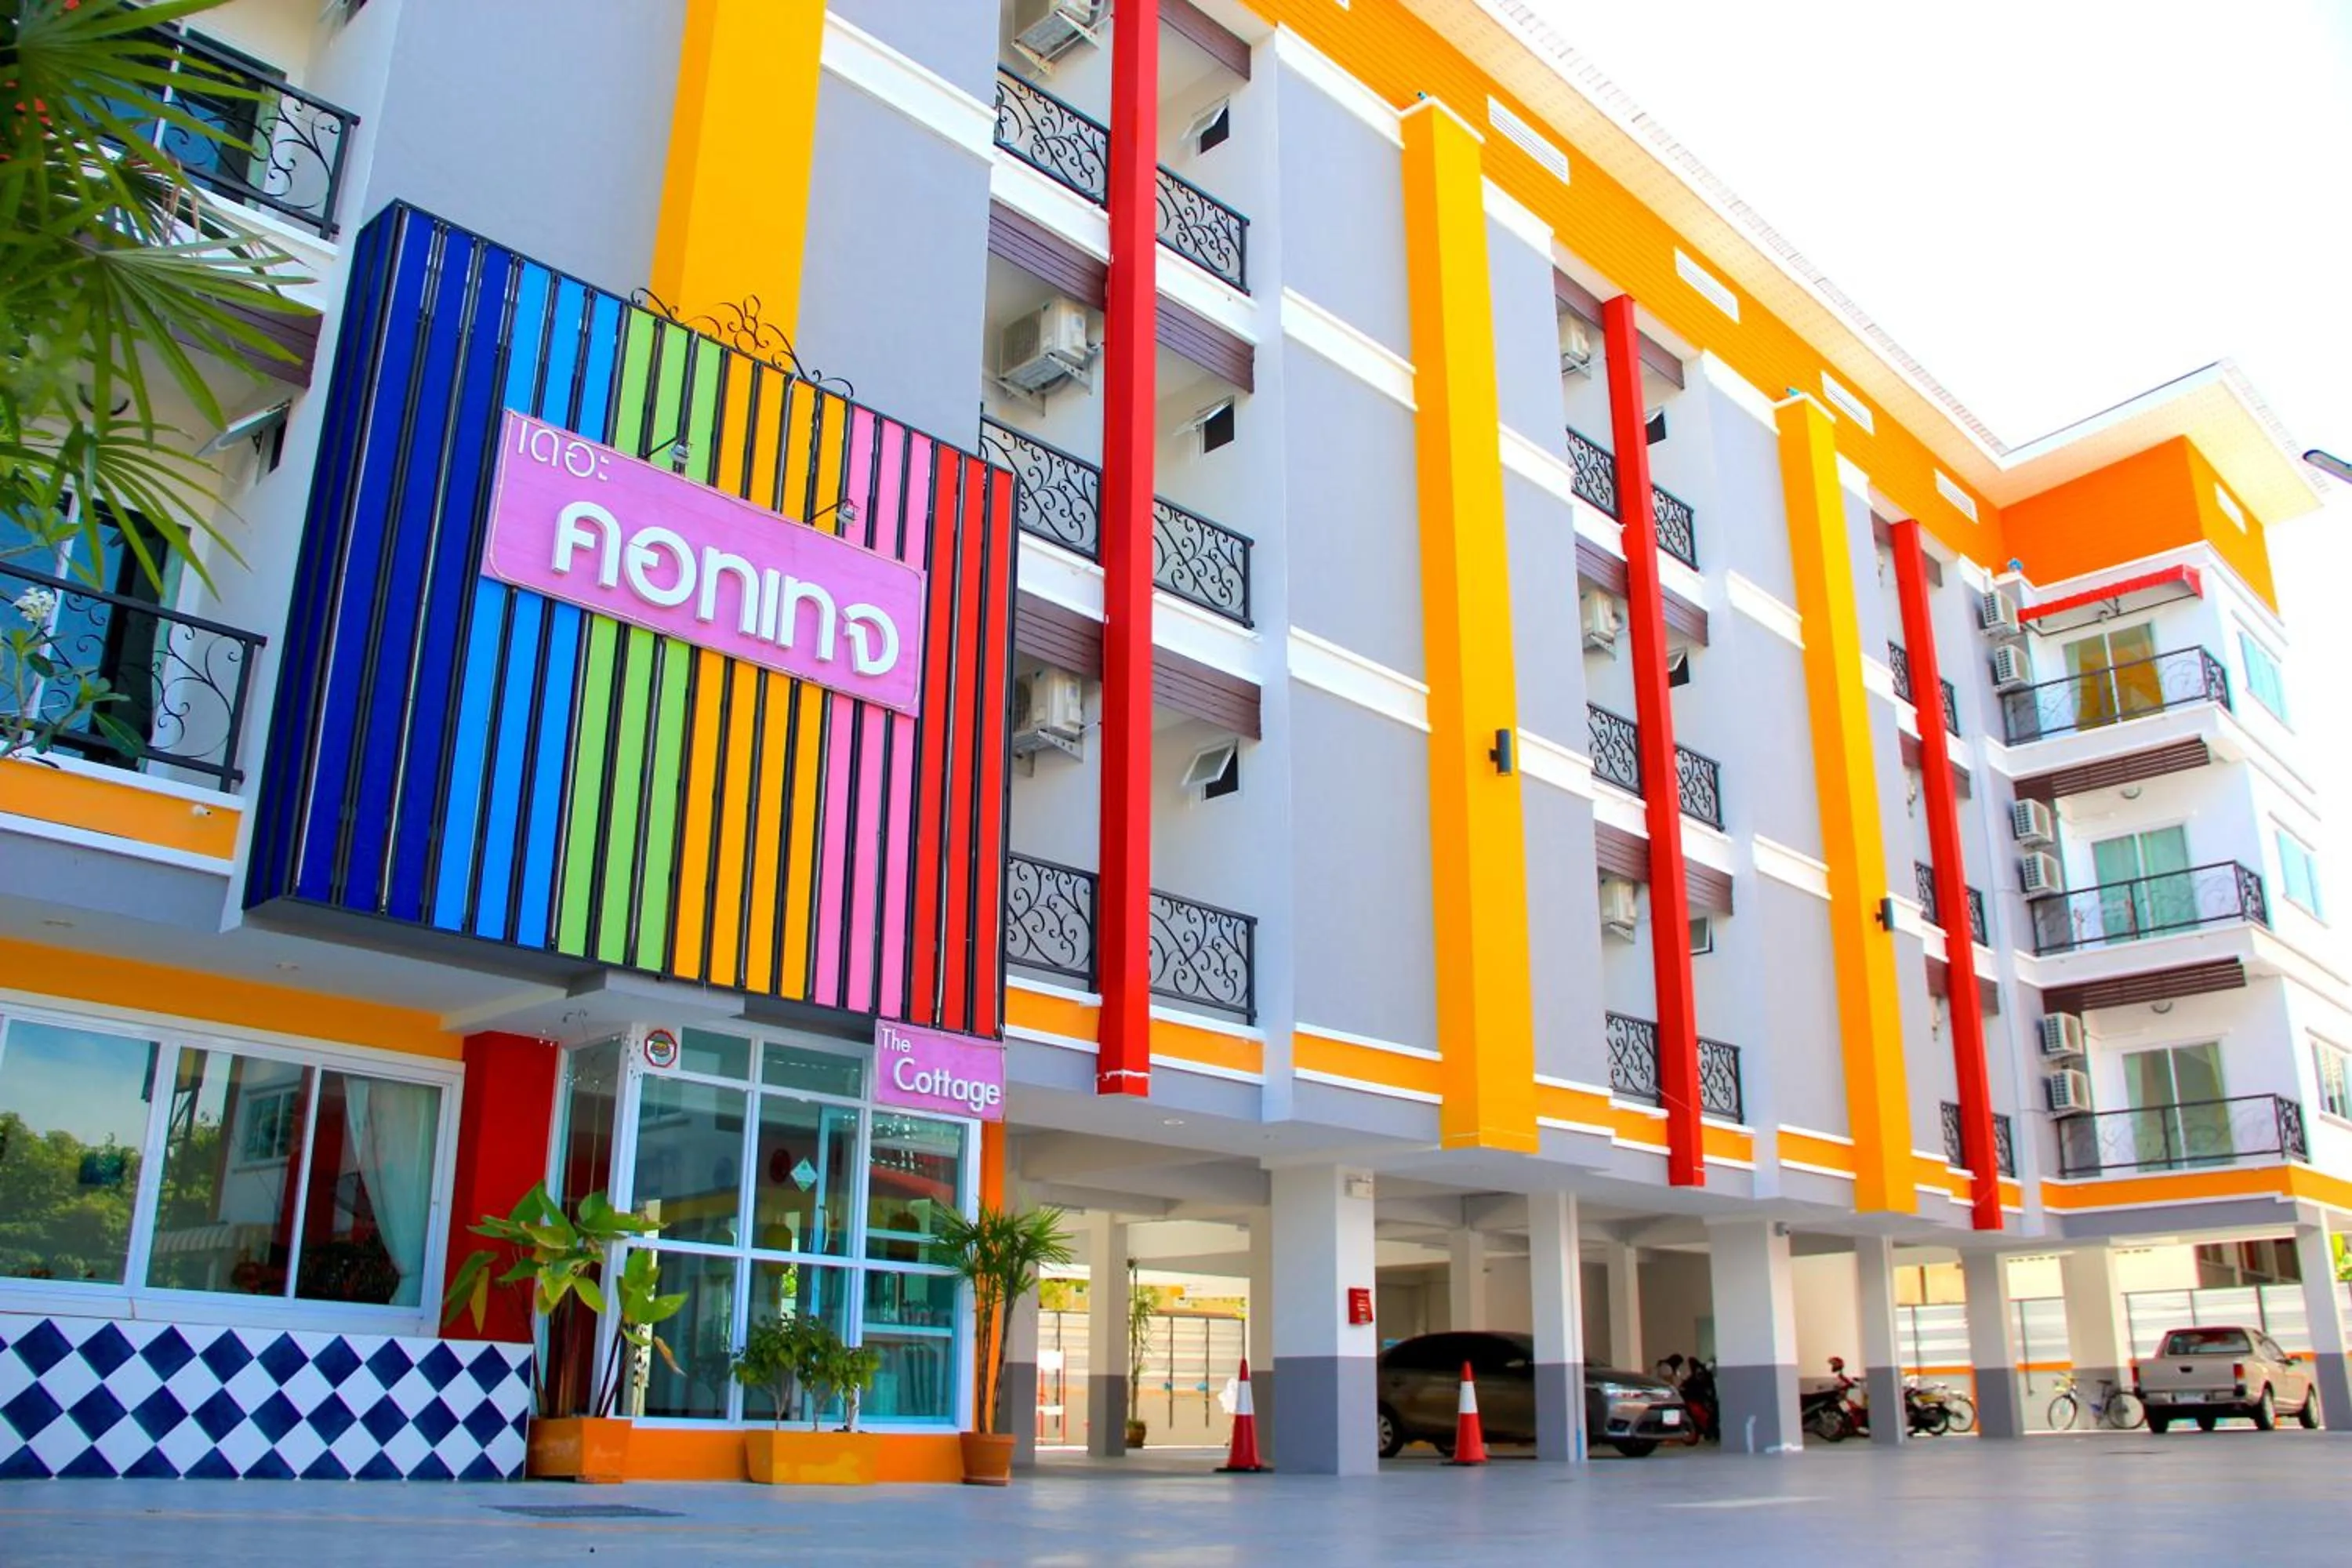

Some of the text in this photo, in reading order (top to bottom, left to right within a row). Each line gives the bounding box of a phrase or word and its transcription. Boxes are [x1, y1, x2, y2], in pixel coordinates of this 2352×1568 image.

[518, 420, 609, 481] เดอะ
[552, 500, 899, 676] คอทเทจ
[881, 1028, 912, 1052] The
[893, 1058, 1001, 1112] Cottage
